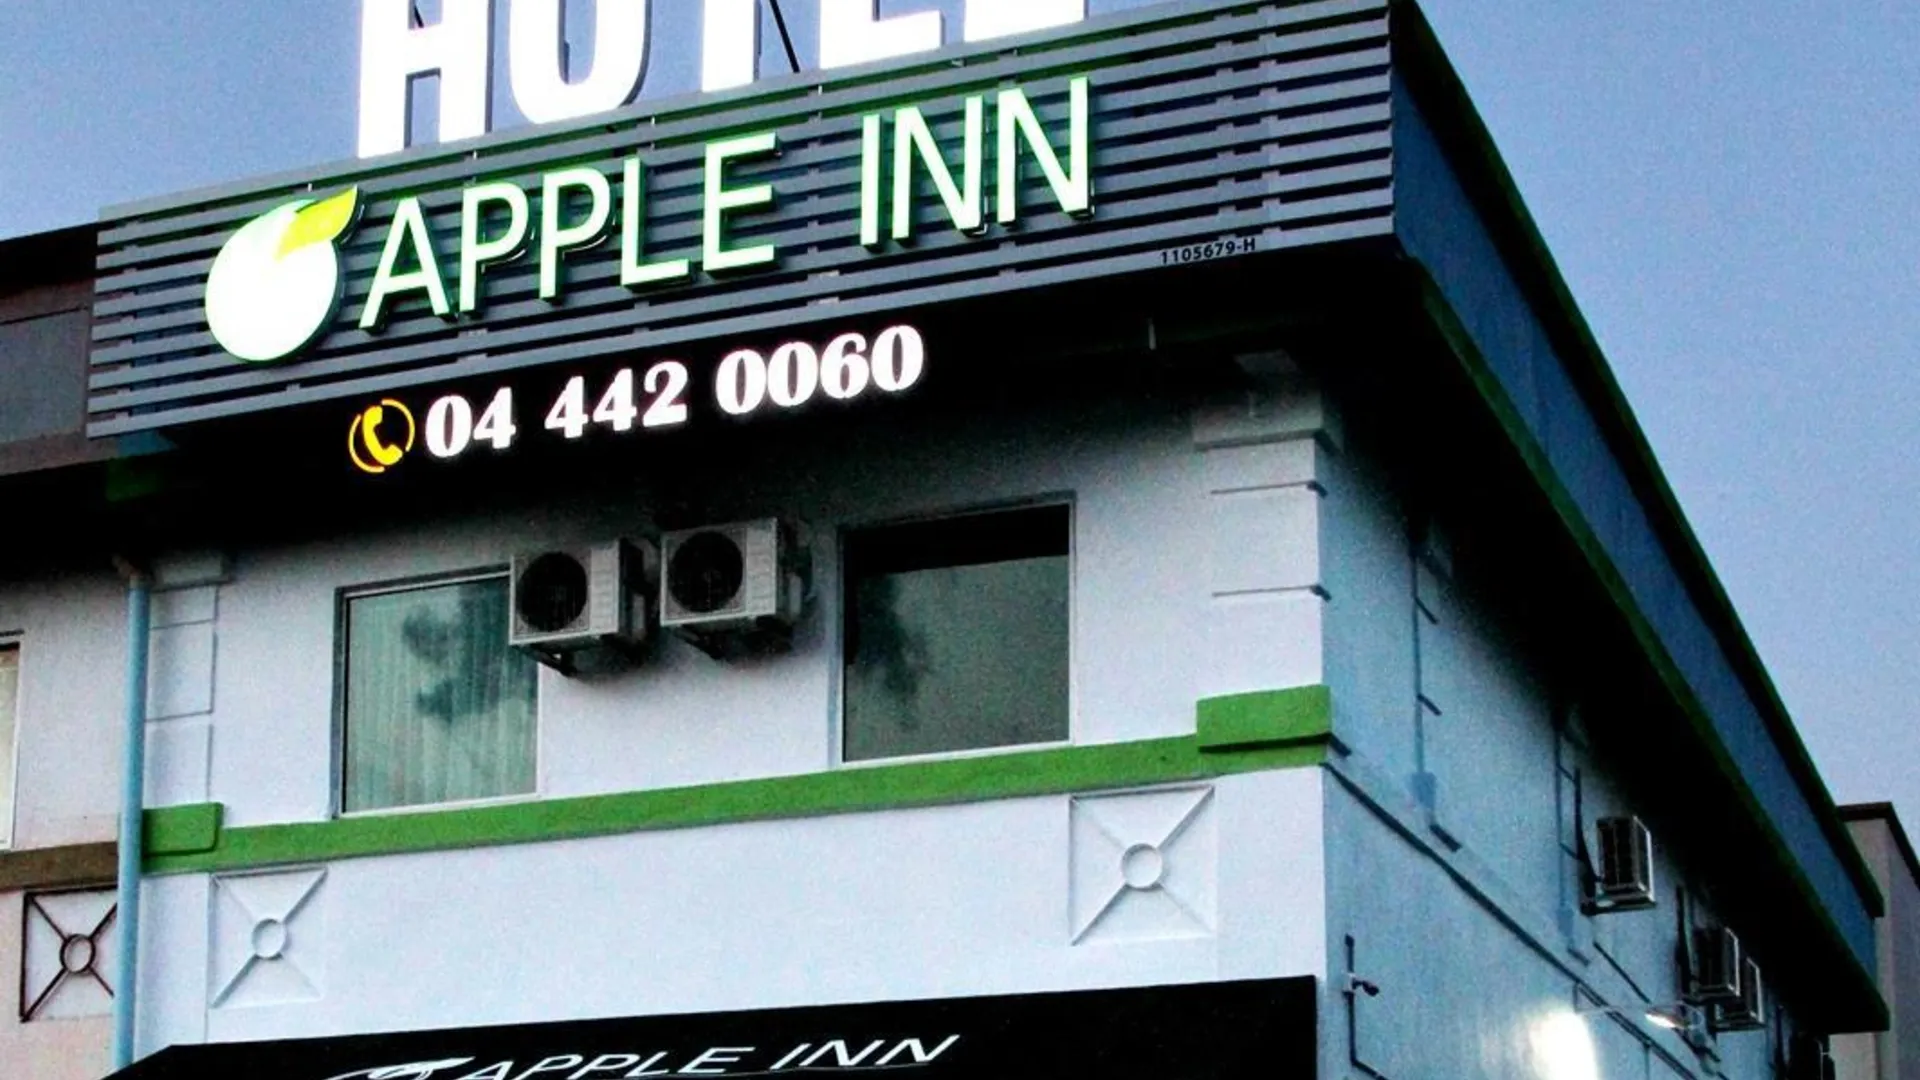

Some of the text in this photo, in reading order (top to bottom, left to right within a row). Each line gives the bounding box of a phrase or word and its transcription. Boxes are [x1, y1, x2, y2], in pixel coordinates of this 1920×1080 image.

[358, 131, 779, 330] APPLE
[859, 76, 1090, 248] INN
[1161, 236, 1257, 265] 1105679-H
[425, 324, 924, 458] 04 442 0060
[454, 1034, 960, 1080] APPLE INN
